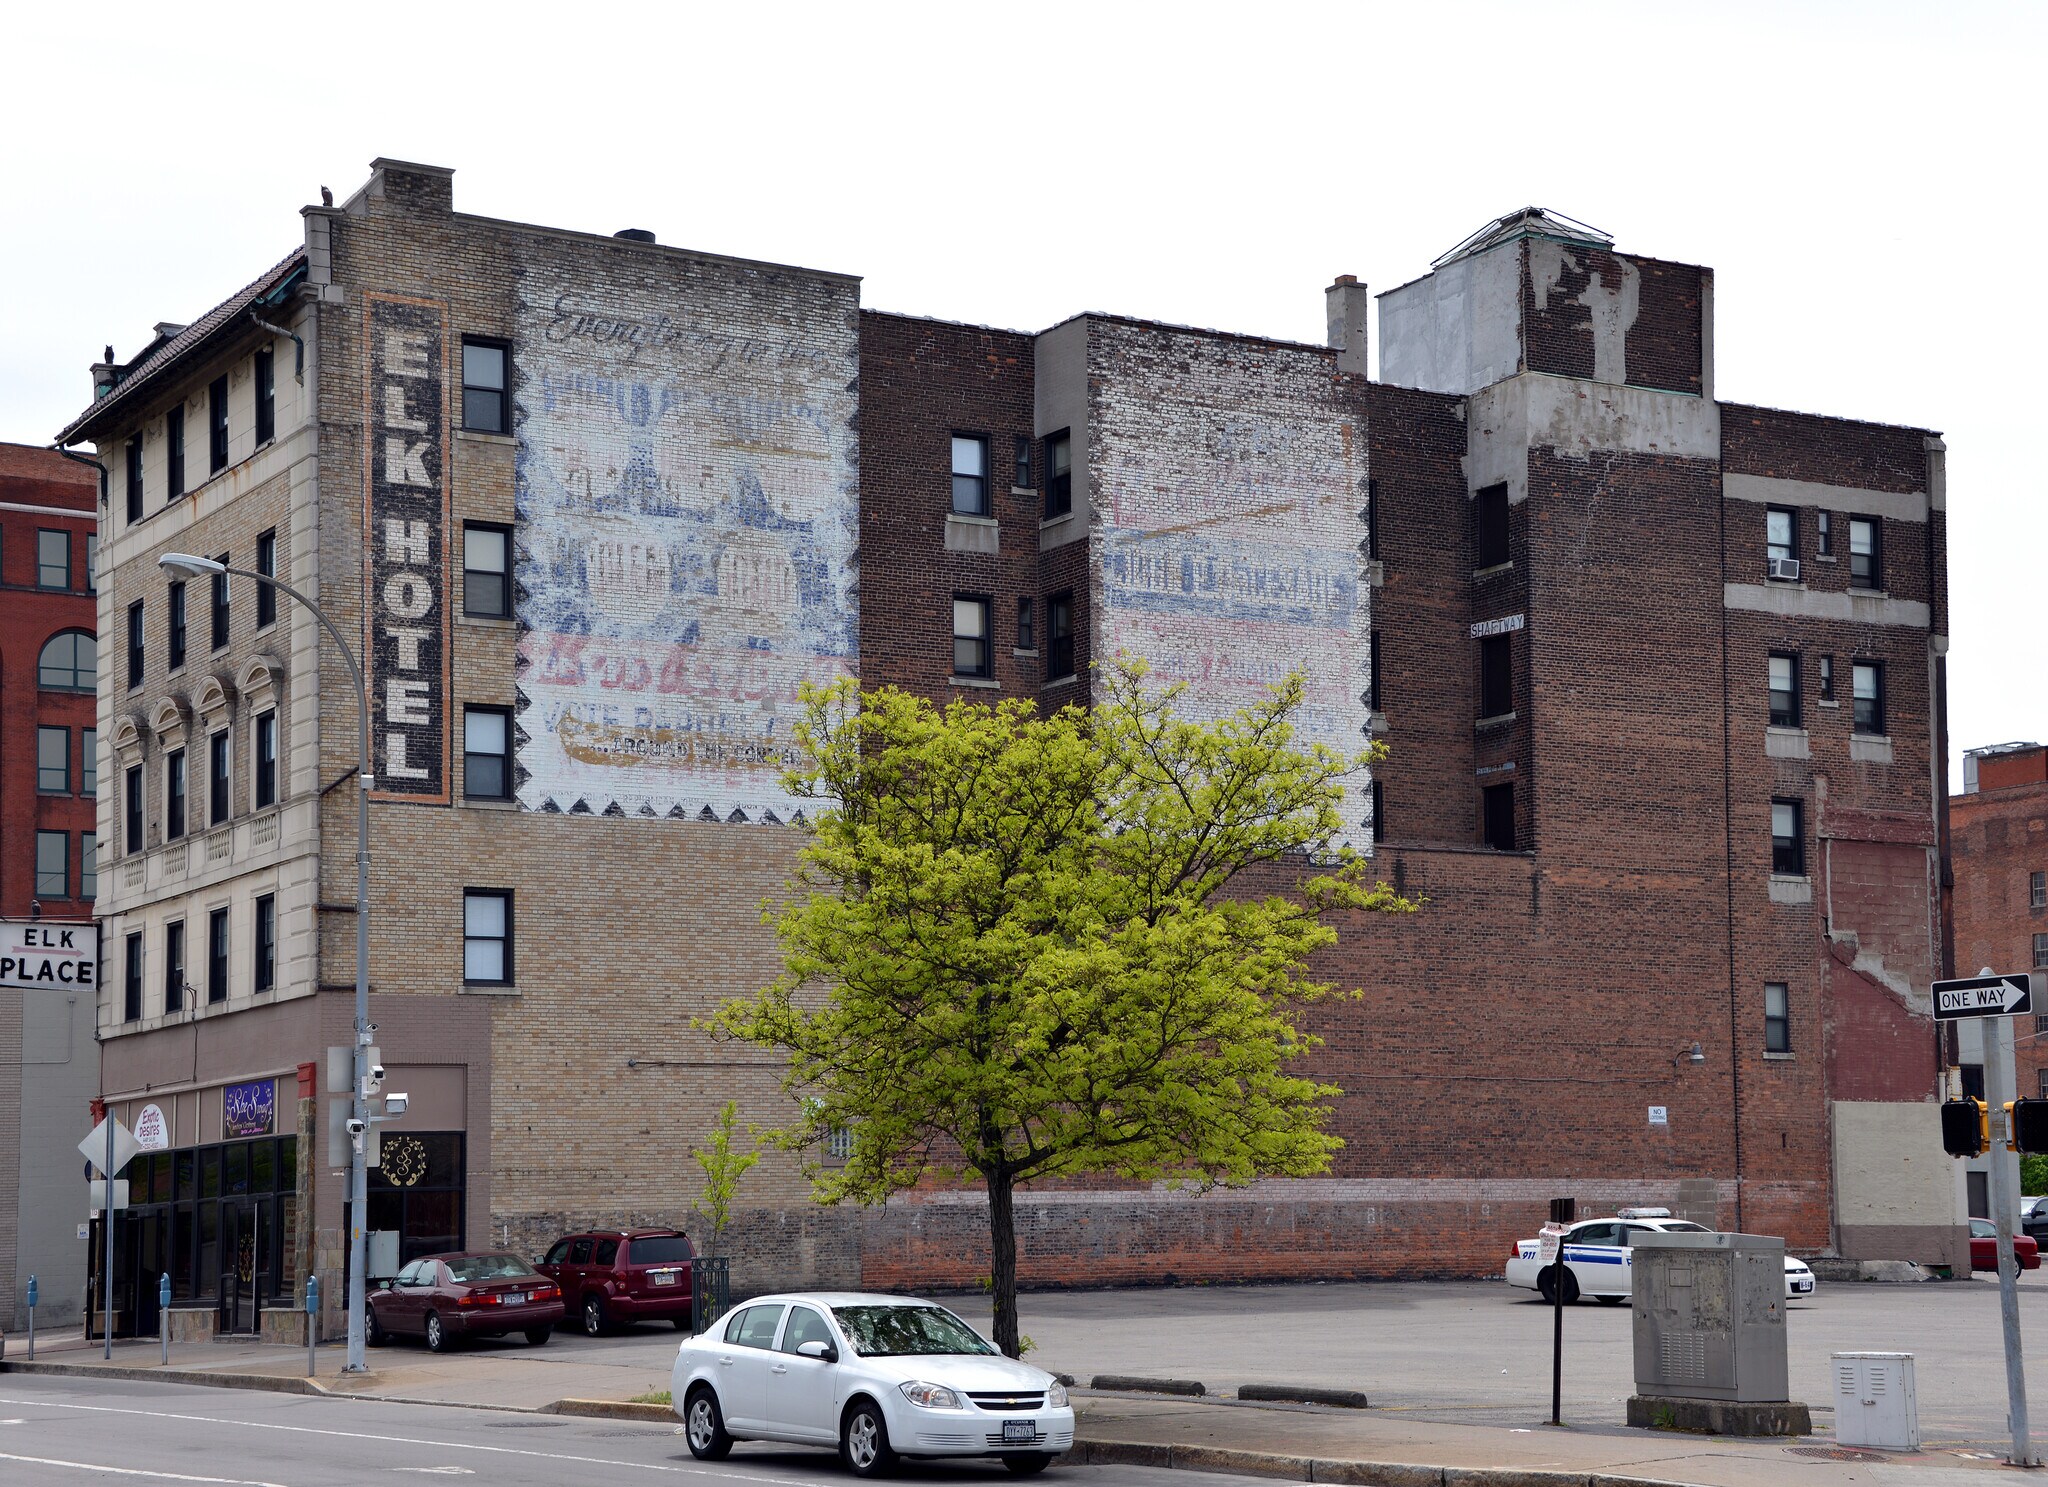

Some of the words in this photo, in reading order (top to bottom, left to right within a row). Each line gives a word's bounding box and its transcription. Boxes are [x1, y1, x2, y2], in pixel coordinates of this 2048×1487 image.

[384, 326, 433, 490] ELK
[1471, 615, 1523, 638] SHAFTWAY
[384, 519, 433, 780] HOTEL
[24, 928, 74, 948] ELK
[0, 957, 94, 984] PLACE
[1941, 991, 1971, 1008] ONE
[1976, 988, 2006, 1005] WAY
[142, 1109, 160, 1125] Exotic
[1523, 1251, 1536, 1259] 911
